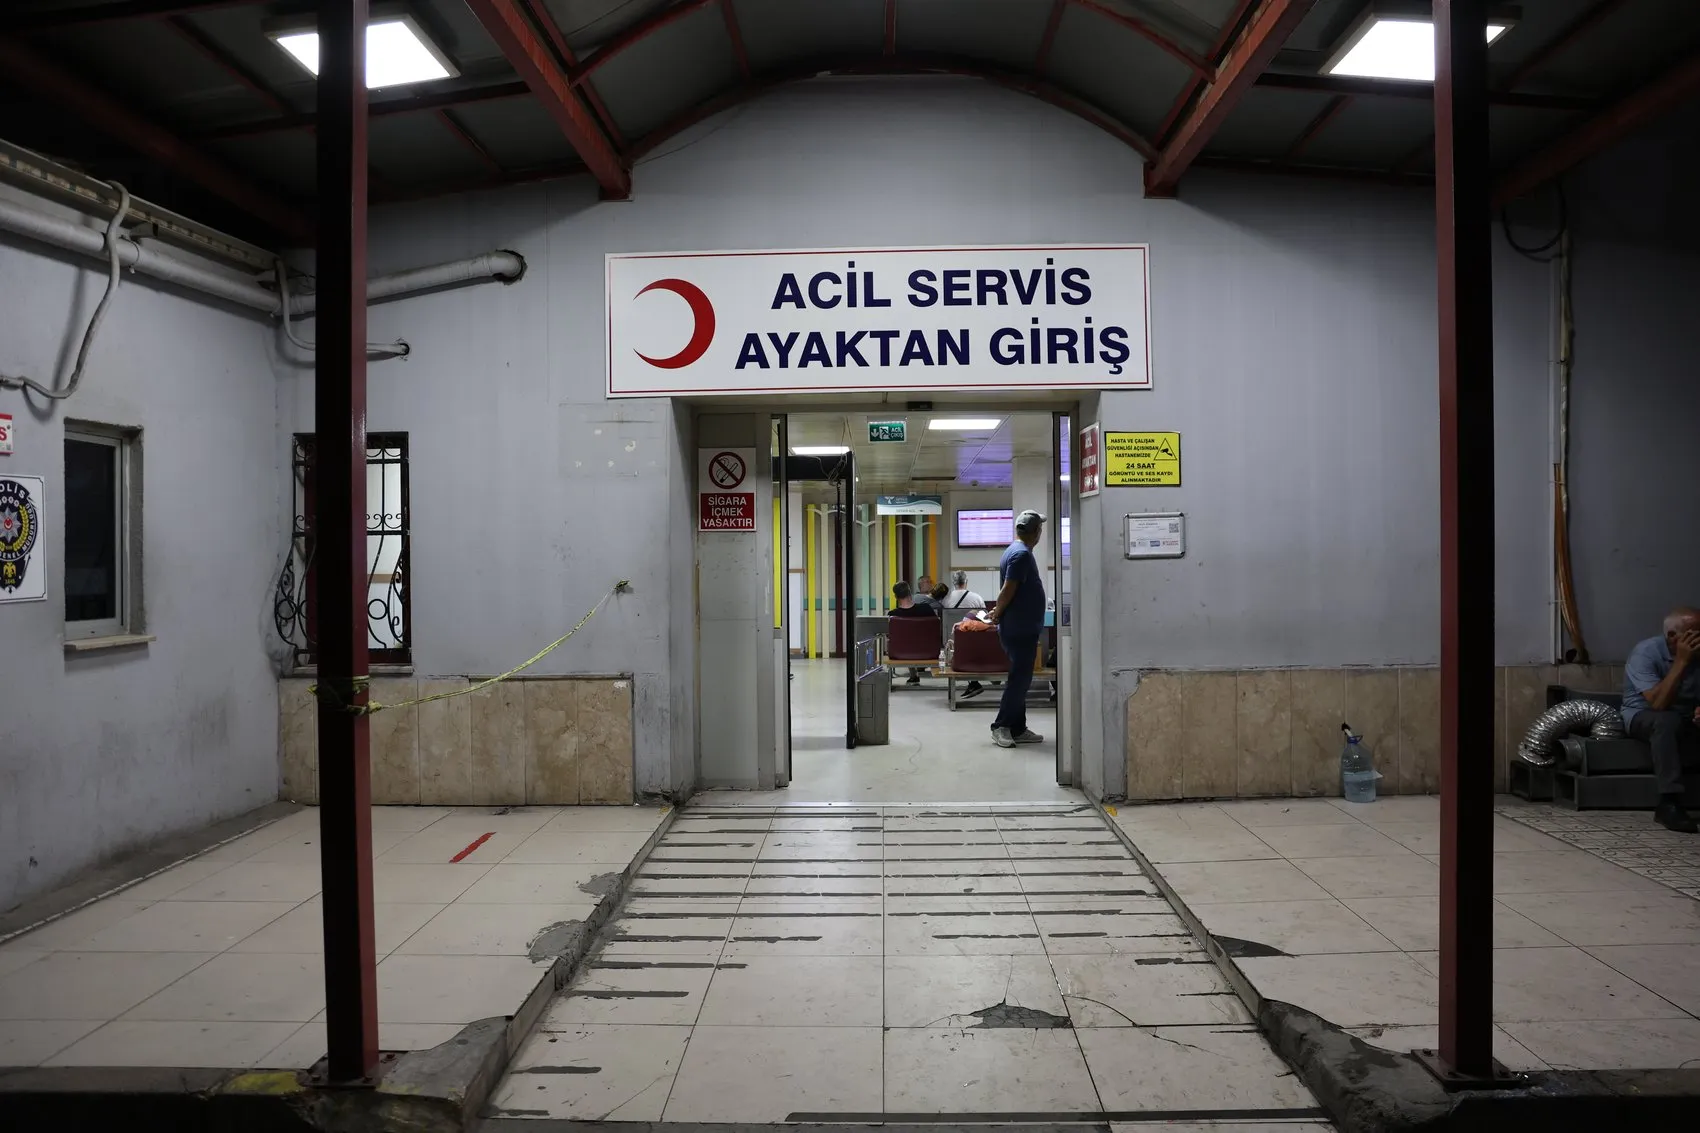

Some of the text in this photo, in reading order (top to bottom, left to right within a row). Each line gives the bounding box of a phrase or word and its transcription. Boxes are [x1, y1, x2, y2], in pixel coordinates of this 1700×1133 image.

[771, 258, 1093, 310] ACİL SERVİS
[734, 316, 1131, 375] AYAKTAN GİRİŞ
[0, 483, 26, 499] OLİS
[708, 494, 747, 505] SİGARA
[711, 506, 743, 518] İÇMEK
[702, 518, 753, 527] YASAKTIR
